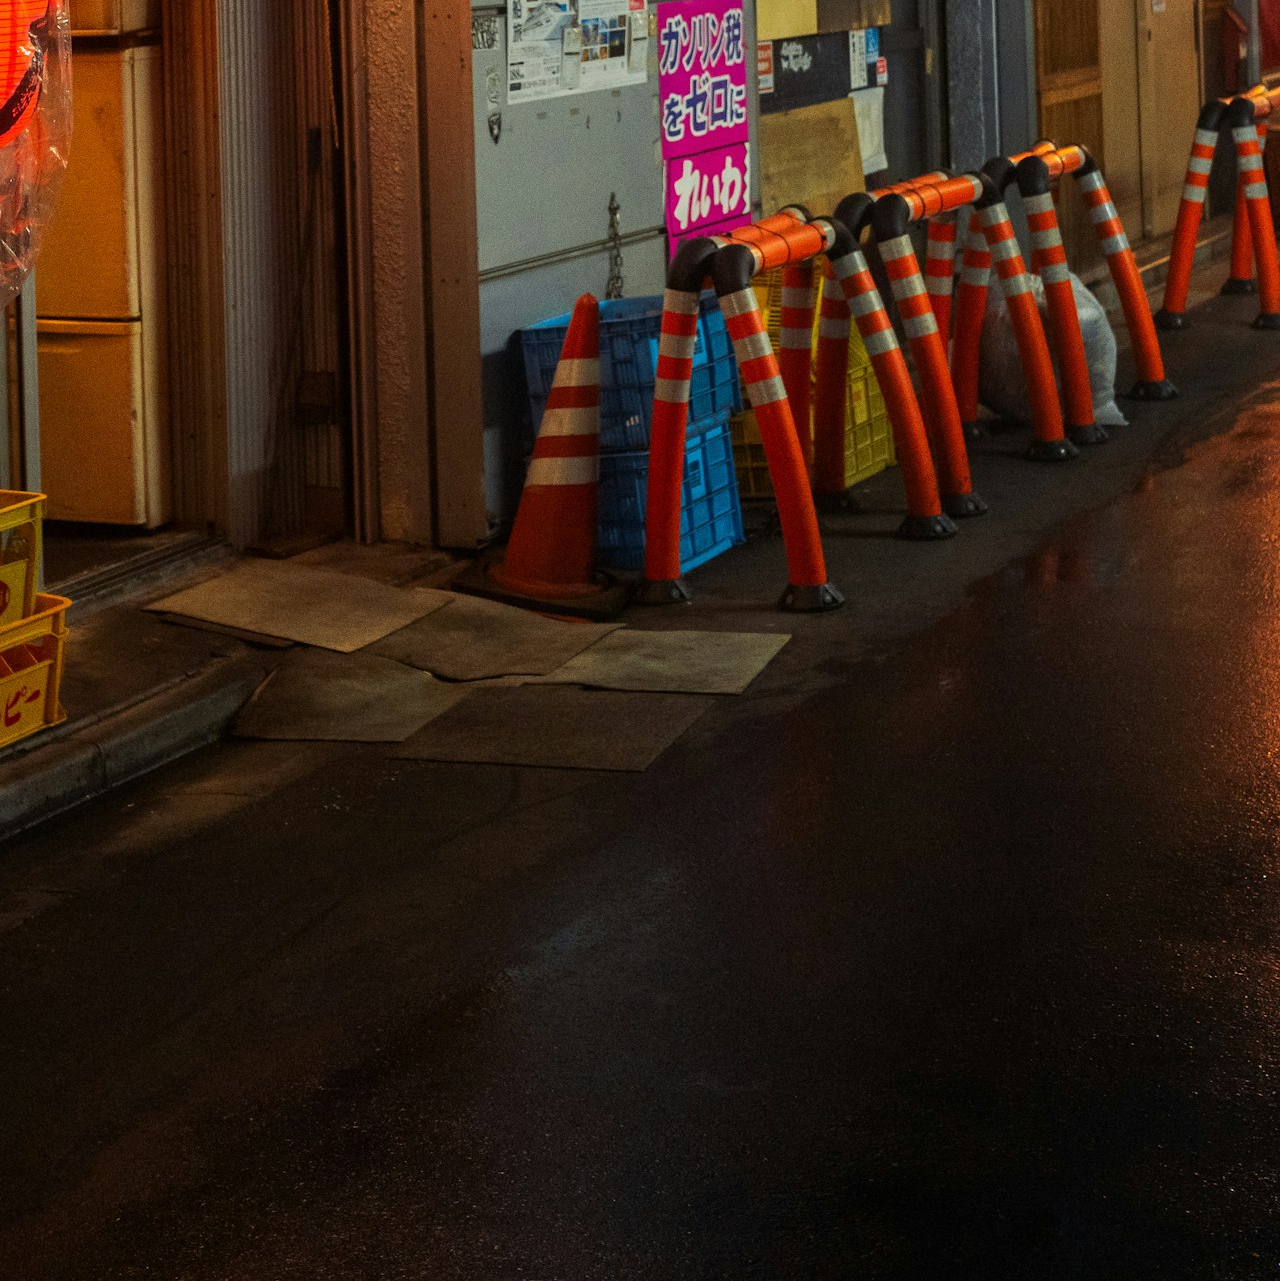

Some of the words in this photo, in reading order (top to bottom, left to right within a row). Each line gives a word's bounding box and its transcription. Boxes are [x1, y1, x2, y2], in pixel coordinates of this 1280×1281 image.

[660, 9, 743, 75] ガソリン税
[664, 73, 747, 141] をゼロに
[674, 156, 743, 230] れいわ
